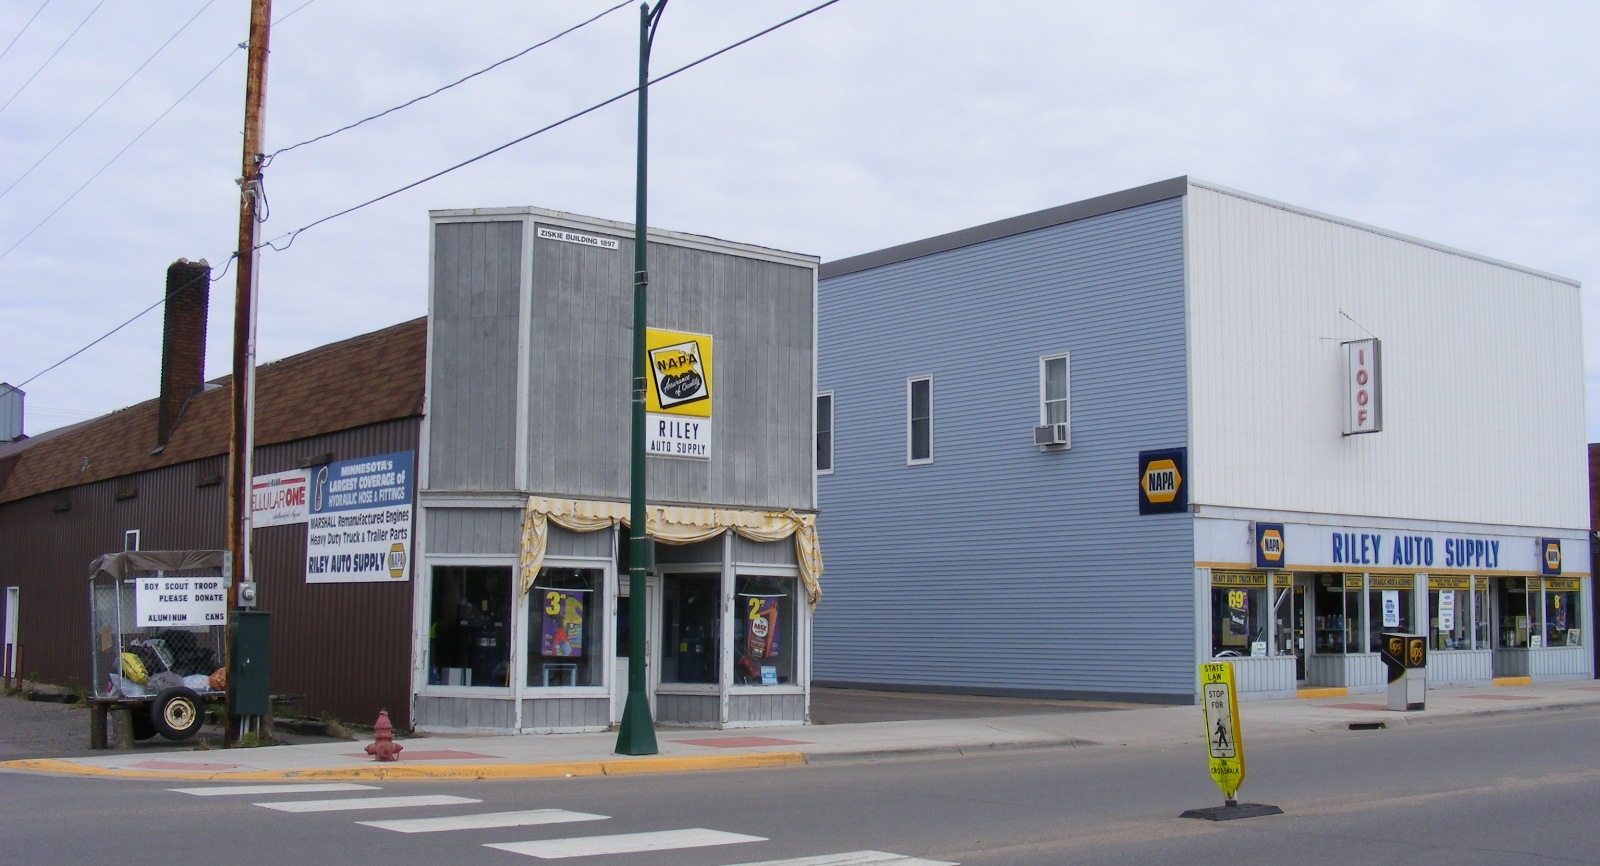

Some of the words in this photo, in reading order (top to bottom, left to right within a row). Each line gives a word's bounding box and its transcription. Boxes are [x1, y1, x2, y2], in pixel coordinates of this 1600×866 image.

[540, 230, 563, 239] ZISKIE
[565, 234, 598, 245] BUILDING
[664, 374, 690, 393] Assurance
[675, 387, 681, 397] of
[681, 377, 700, 392] Quality
[659, 420, 699, 440] RILEY
[651, 440, 671, 452] AUTO
[676, 442, 705, 455] SUPPLY
[341, 460, 393, 476] MINNESOTA'S
[329, 477, 357, 493] LARGEST
[358, 472, 395, 489] COVERAGE
[1149, 471, 1174, 491] NAPA
[252, 486, 306, 511] ELLULARONE
[328, 492, 357, 508] HYDRAULIC
[358, 490, 373, 504] HOSE
[379, 486, 405, 501] FITTINGS
[310, 516, 336, 529] MARSHALL
[338, 511, 384, 527] Remanufactured
[386, 510, 409, 525] Engines
[310, 533, 326, 546] Heavy
[327, 532, 341, 546] Duty
[343, 531, 360, 544] Truck
[361, 532, 365, 543] &
[367, 529, 388, 542] Trailer
[390, 527, 408, 540] Parts
[1265, 538, 1279, 552] NAPA
[1332, 532, 1381, 564] RILEY
[1392, 535, 1434, 566] AUTO
[1445, 538, 1500, 568] SUPPLY
[308, 555, 329, 574] RILEY
[330, 554, 352, 573] AUTO
[353, 552, 386, 572] SUPPLY
[391, 552, 403, 568] NAPA
[1548, 551, 1558, 562] NAPA
[165, 582, 189, 590] SCOUT
[1213, 574, 1226, 583] HEAVY
[1226, 574, 1238, 583] DUTY
[1239, 574, 1252, 583] TRUCK
[1252, 575, 1265, 583] PARTS
[159, 594, 188, 602] PLEASE
[195, 594, 224, 602] DONATE
[148, 614, 187, 622] ALUMINUM
[754, 623, 767, 631] MAX
[1391, 643, 1401, 653] ups
[1411, 647, 1423, 661] ups
[1204, 664, 1224, 672] STATE
[1208, 673, 1222, 681] LAW
[1208, 690, 1224, 698] STOP
[1211, 701, 1224, 709] FOR
